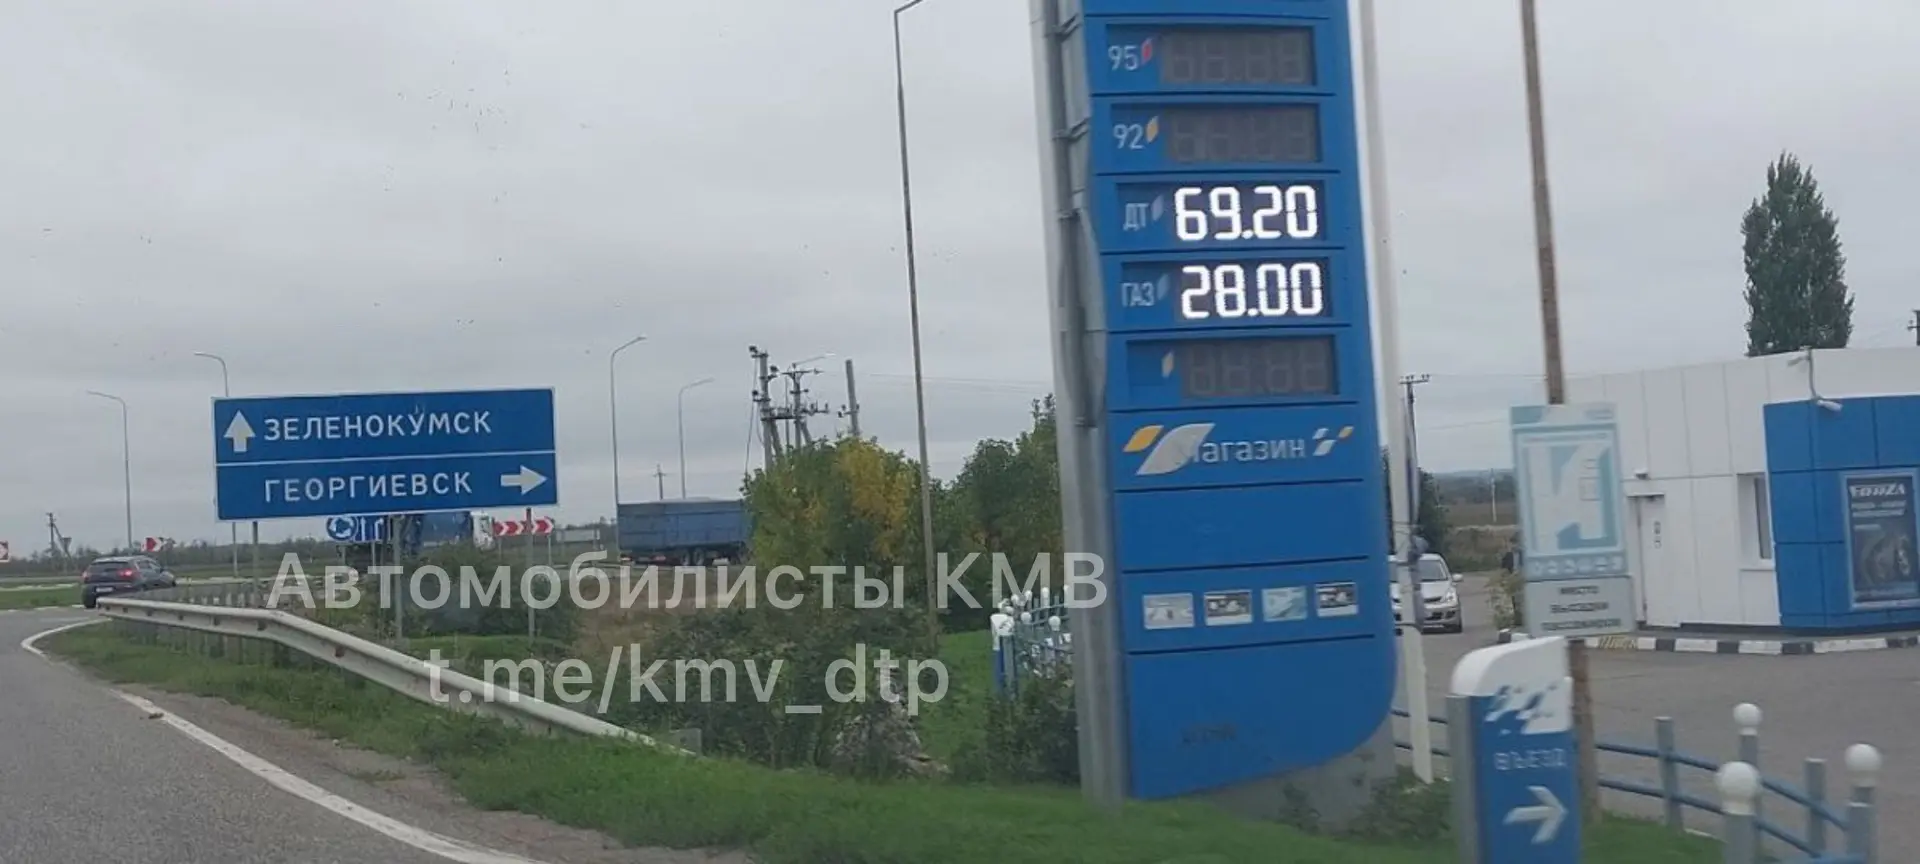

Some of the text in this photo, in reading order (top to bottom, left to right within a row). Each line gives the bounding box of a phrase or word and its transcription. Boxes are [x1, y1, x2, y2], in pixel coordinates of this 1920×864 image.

[1108, 45, 1139, 71] 95
[1113, 123, 1145, 150] 92
[1123, 185, 1318, 241] ДТ 69.20
[1121, 262, 1324, 319] ГАЗ 28.00
[263, 410, 492, 442] ЗЕЛЕНОКУМСК
[264, 472, 473, 503] ГЕОРГИЕВСК
